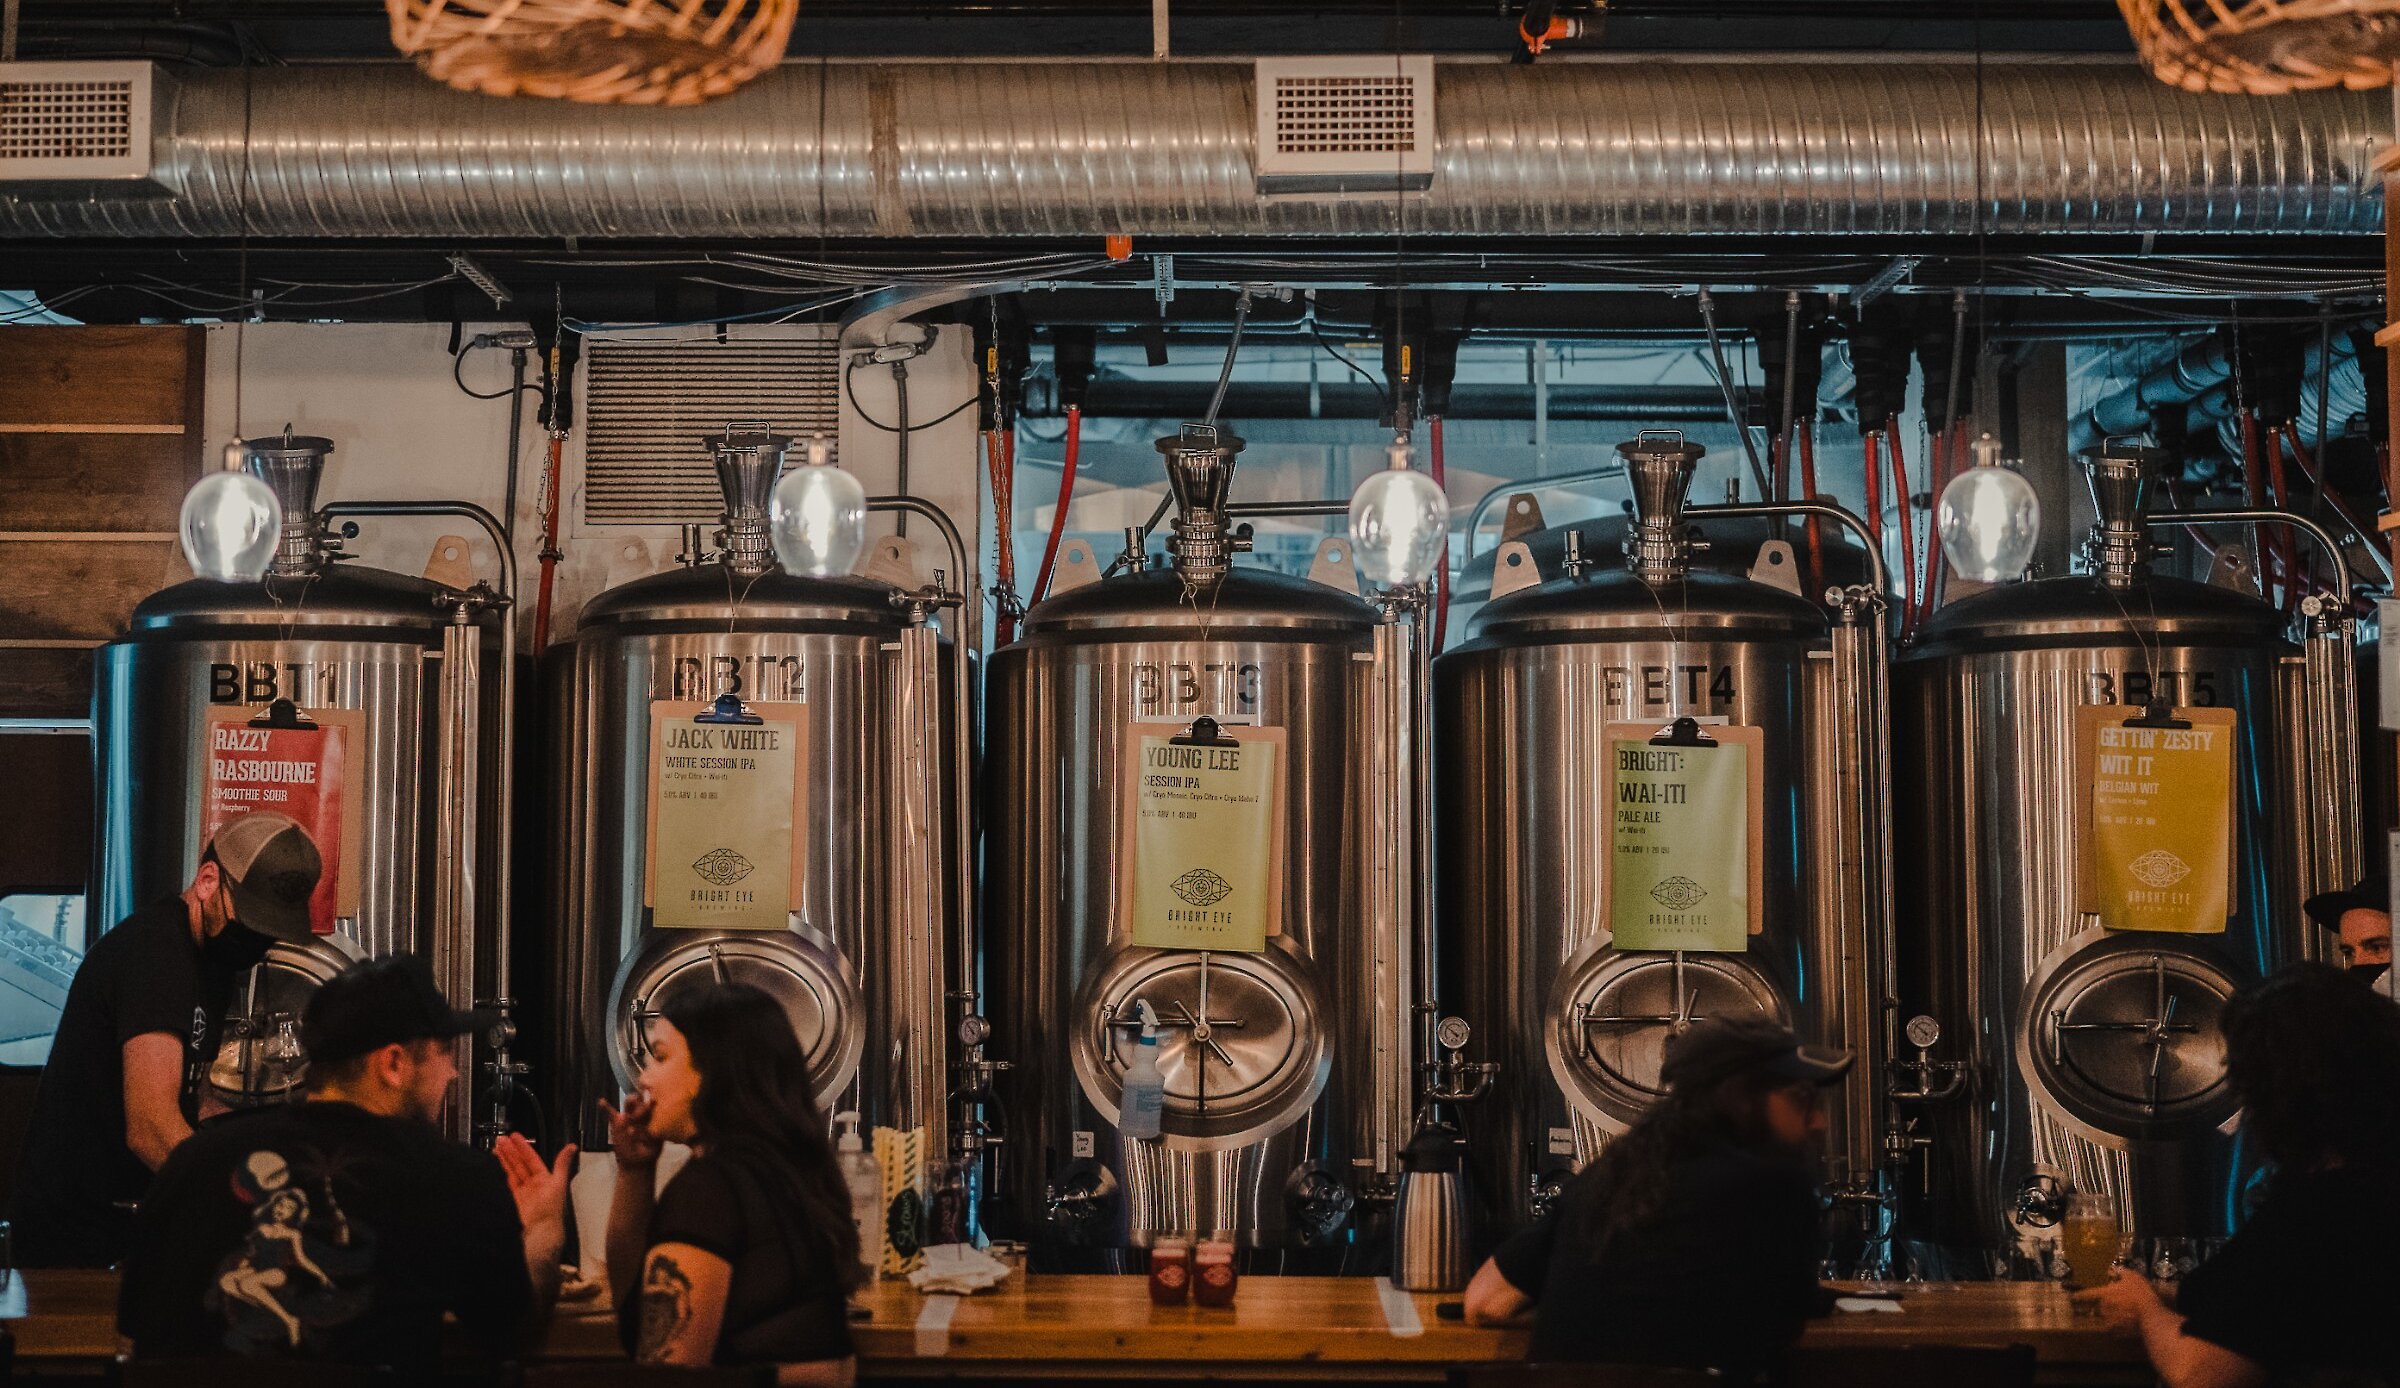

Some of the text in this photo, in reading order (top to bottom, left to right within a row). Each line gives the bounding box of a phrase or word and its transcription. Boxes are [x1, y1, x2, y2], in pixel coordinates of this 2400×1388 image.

[214, 728, 272, 752] RAZZY
[666, 728, 780, 751] JACK WHITE
[2100, 727, 2214, 751] GETTIN' ZESTY
[665, 756, 756, 770] WHITE SESSION IPA
[1147, 747, 1240, 771] YOUNG LEE
[1618, 750, 1684, 772] BRIGHT:
[2100, 754, 2154, 776] WIT IT
[211, 759, 317, 784] RASBOURNE
[1144, 775, 1200, 789] SESSION IPA
[2099, 780, 2160, 794] BELGIAN WIT
[211, 787, 288, 802] SMOOTHIE SOUR
[1618, 782, 1687, 804] WAI-ITI
[220, 803, 250, 813] Raspberry
[1618, 811, 1661, 823] PALE ALE
[690, 890, 753, 903] BRIGHT EYE
[1168, 909, 1232, 923] BRIGHT EYE
[1649, 914, 1708, 926] BRIGHT EYE
